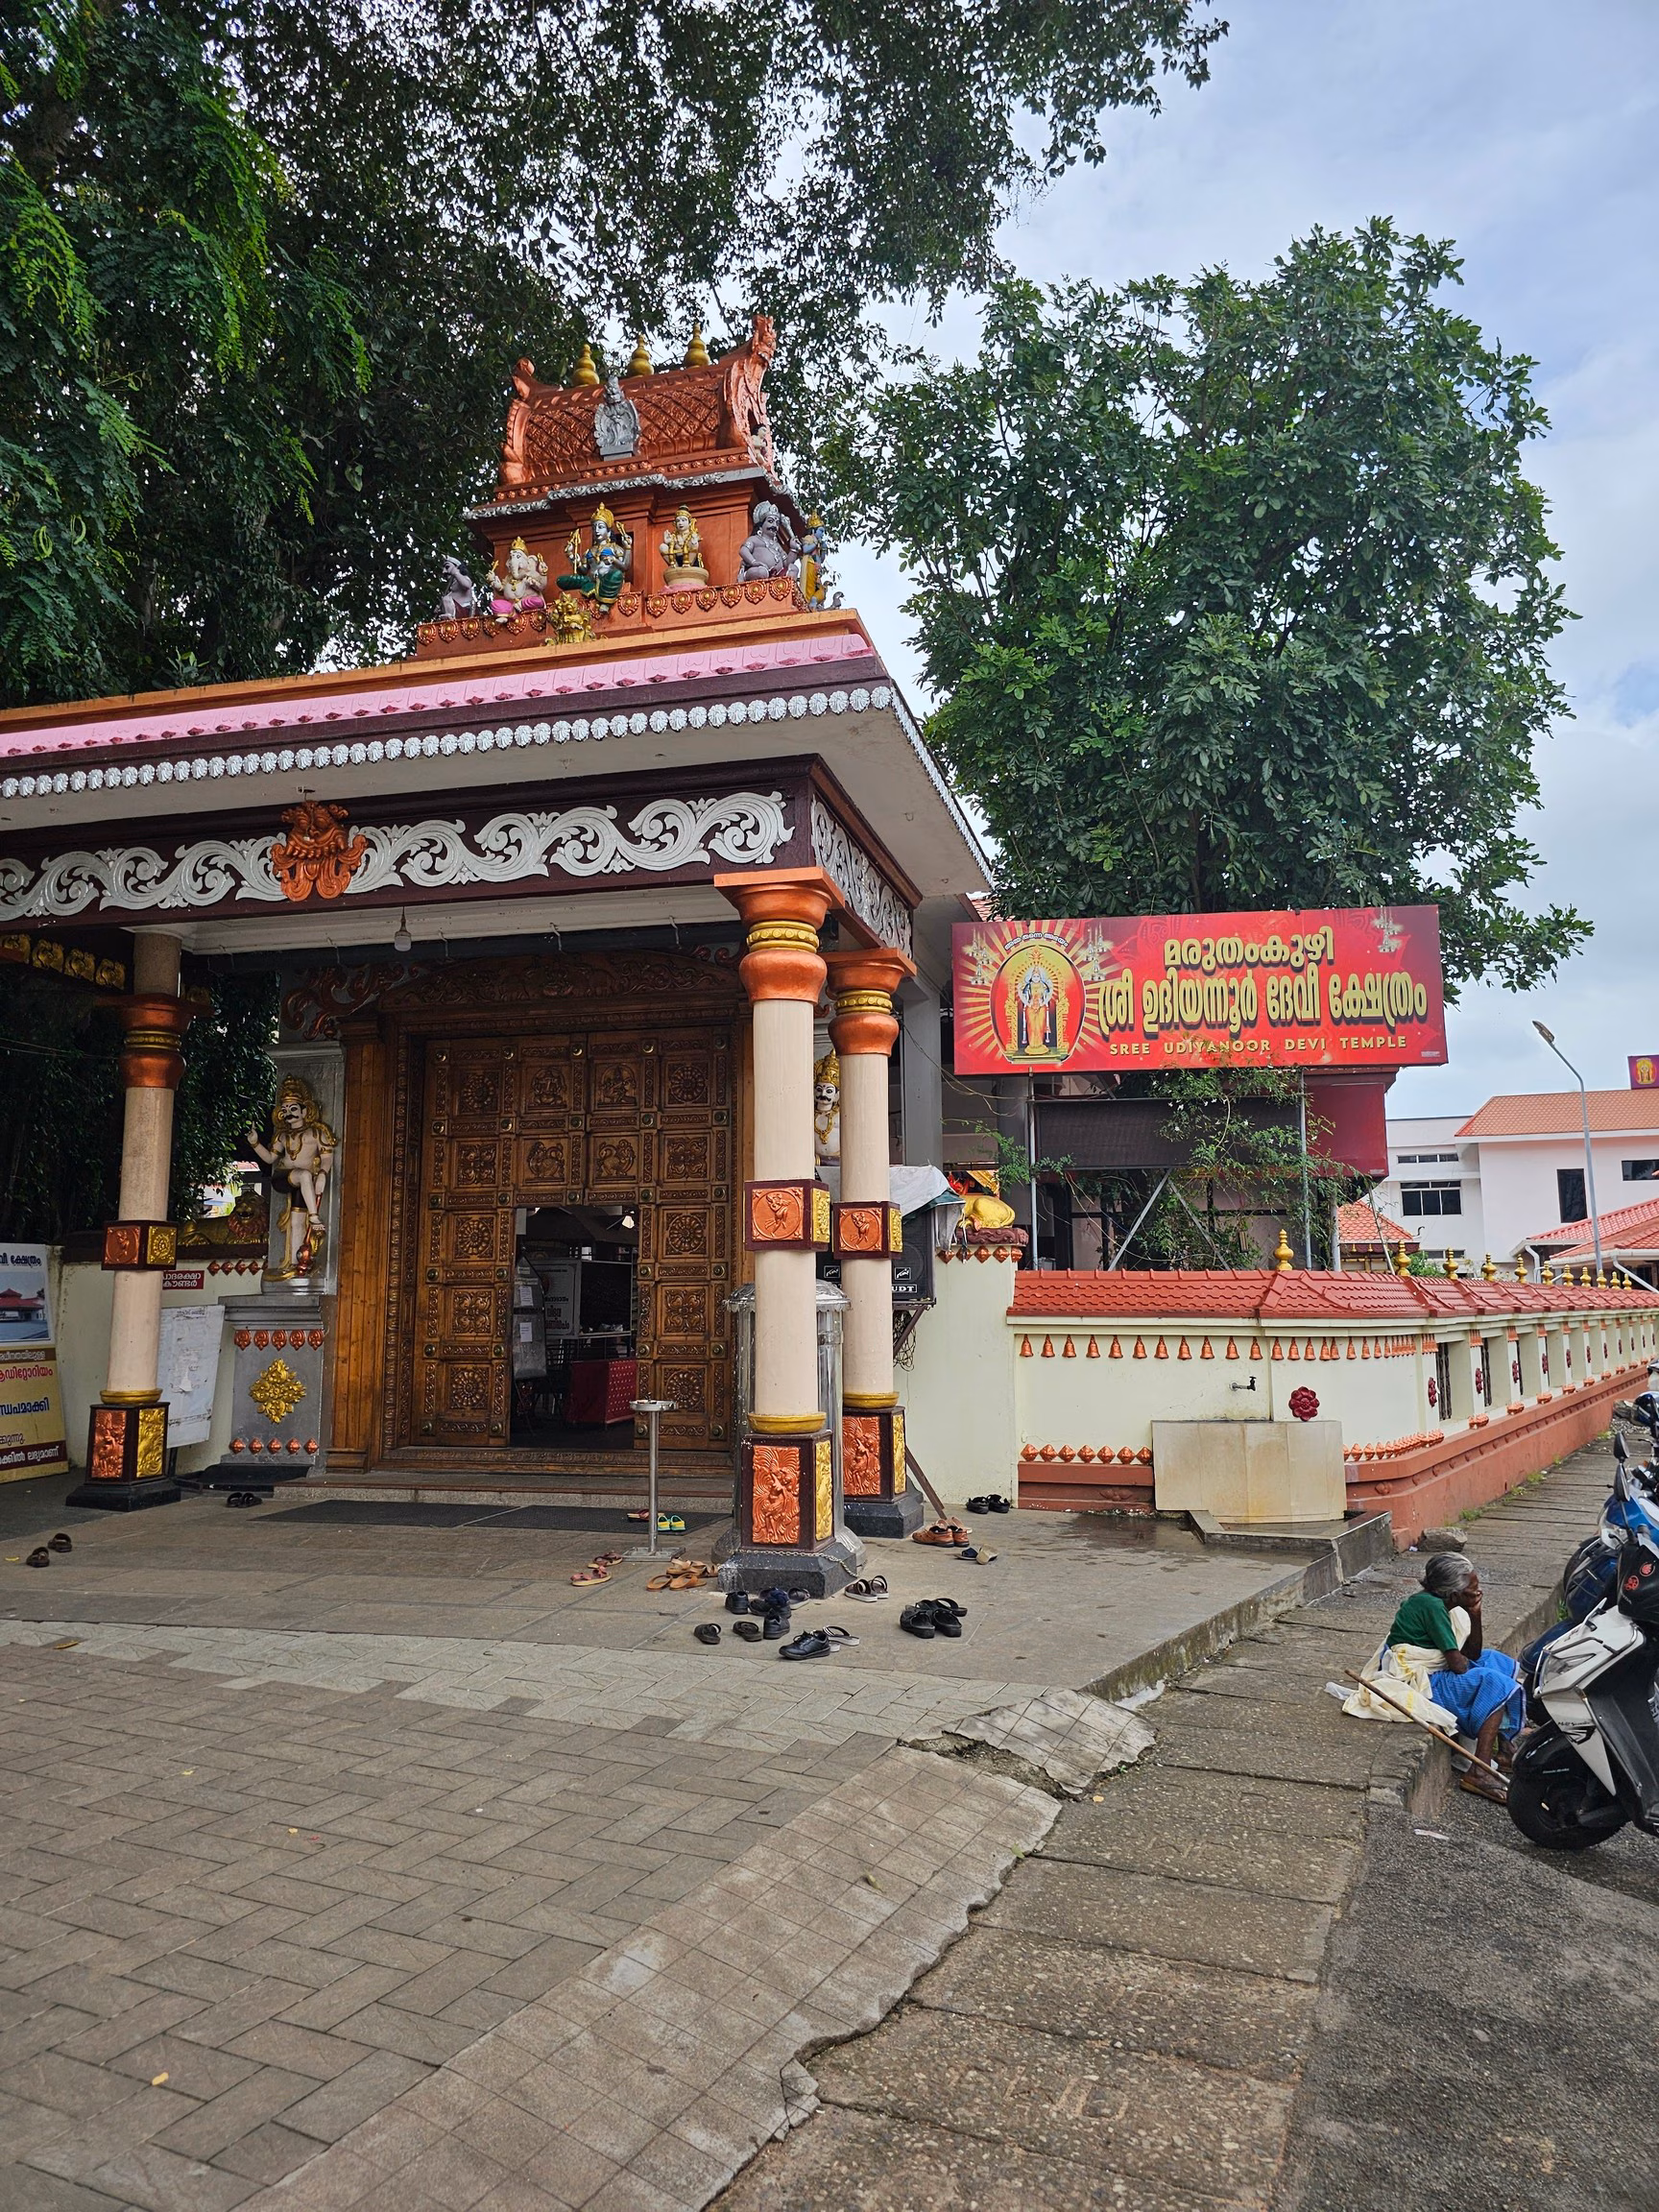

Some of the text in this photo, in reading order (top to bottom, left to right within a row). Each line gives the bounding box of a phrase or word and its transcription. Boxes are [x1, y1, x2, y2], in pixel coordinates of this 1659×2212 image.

[1164, 926, 1334, 972] മരുതംകുഴി
[1097, 962, 1428, 1036] ശ്രീ ഉദിയന്നൂർ ദേവീ ക്ഷേത്രം
[1109, 1036, 1407, 1055] SREE UDIYANOOR DEVI TEMPLE
[11, 1254, 41, 1266] ക്ഷേത്രം
